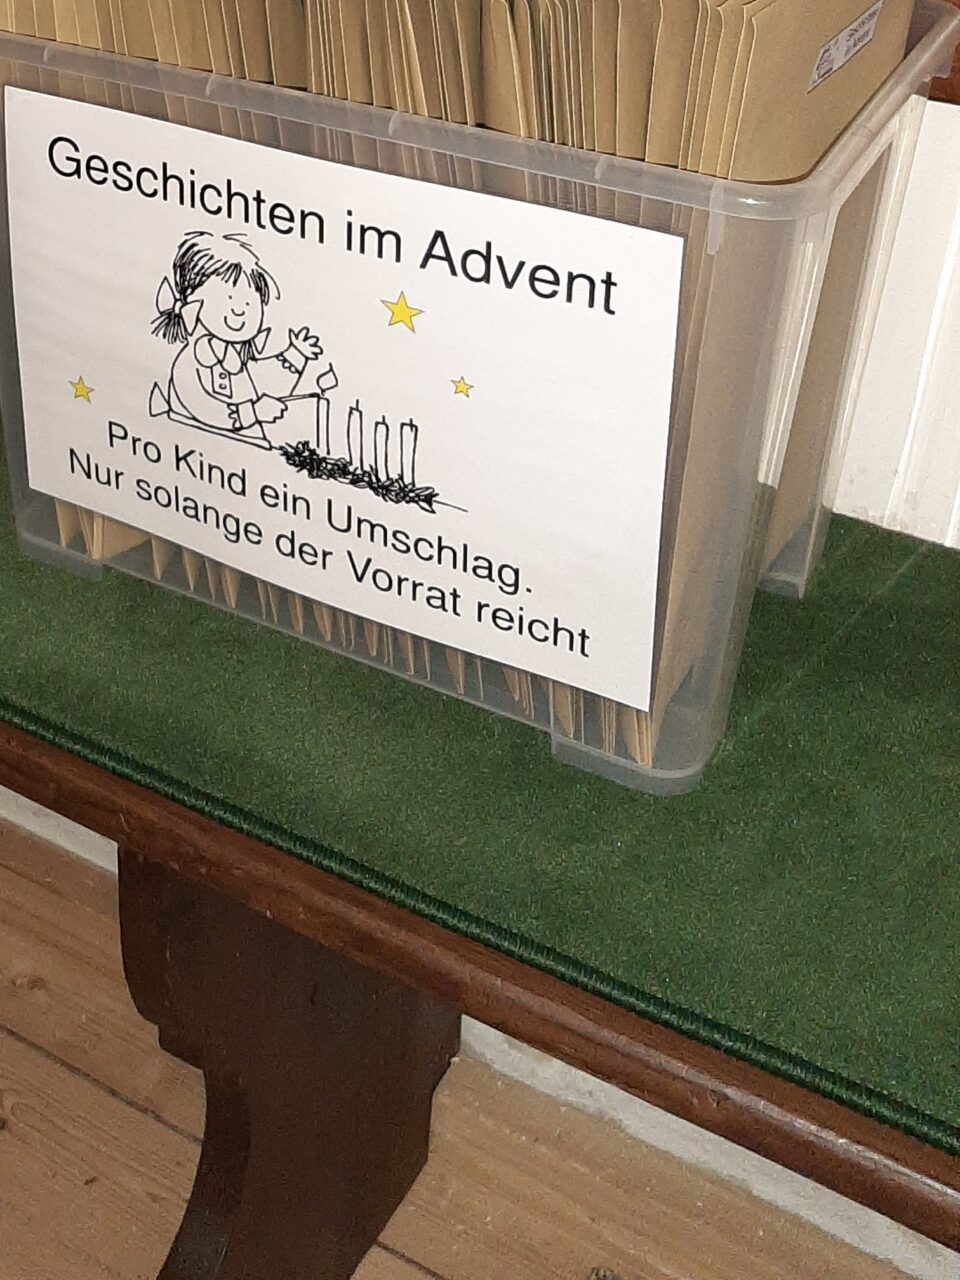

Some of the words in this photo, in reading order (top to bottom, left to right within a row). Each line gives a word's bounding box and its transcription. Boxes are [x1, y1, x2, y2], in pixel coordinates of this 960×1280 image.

[49, 137, 323, 243] Geschichten
[347, 210, 401, 262] im
[420, 231, 617, 314] Advent
[70, 449, 124, 489] Nur
[136, 469, 262, 544] solange
[276, 531, 332, 569] der
[347, 550, 460, 616] Vorrat
[478, 602, 589, 657] reicht
[109, 421, 161, 463] Pro
[175, 445, 245, 496] Kind
[261, 484, 310, 519] ein
[326, 499, 531, 593] Umschlag.
